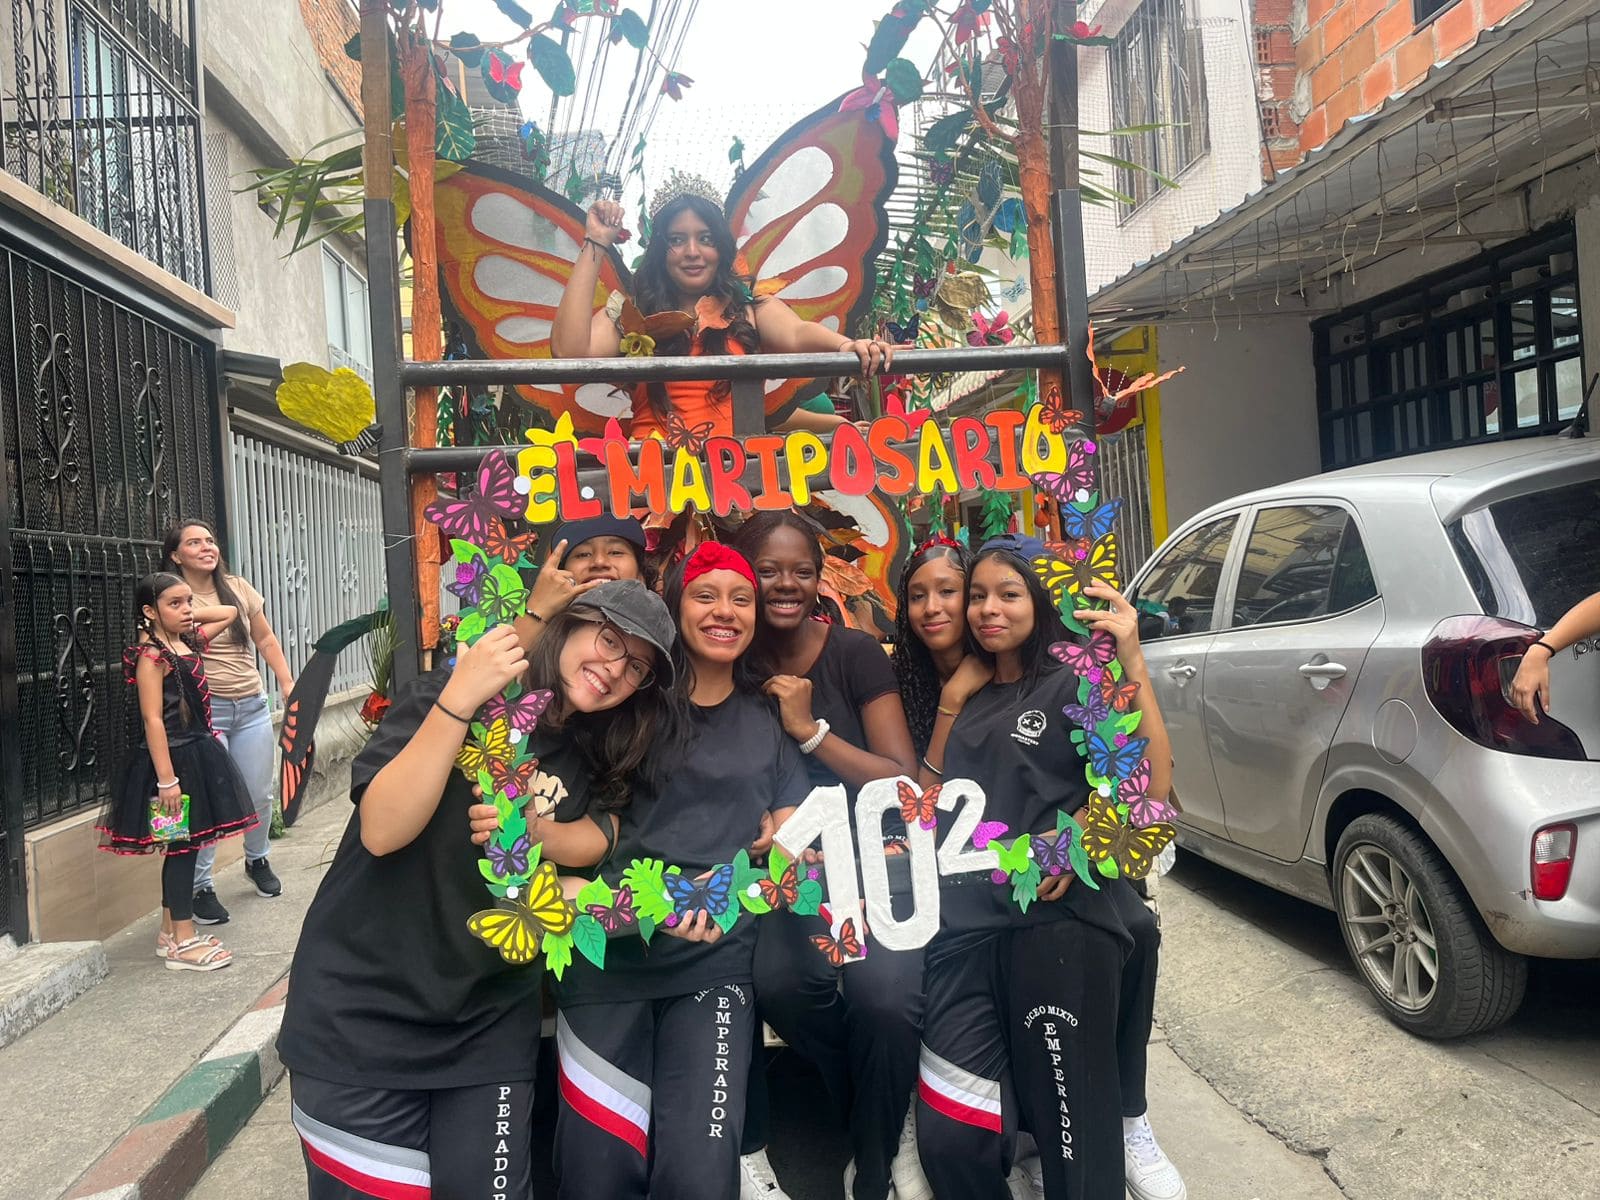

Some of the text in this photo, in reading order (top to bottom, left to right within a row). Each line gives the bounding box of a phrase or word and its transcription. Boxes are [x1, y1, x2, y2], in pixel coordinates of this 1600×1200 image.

[516, 402, 1068, 524] EL MARIPOSARIO
[773, 775, 1000, 964] 102
[709, 996, 732, 1138] EMPERADOR
[1024, 1005, 1078, 1029] LICEO MIXTO
[1043, 1022, 1074, 1161] EMPERADOR
